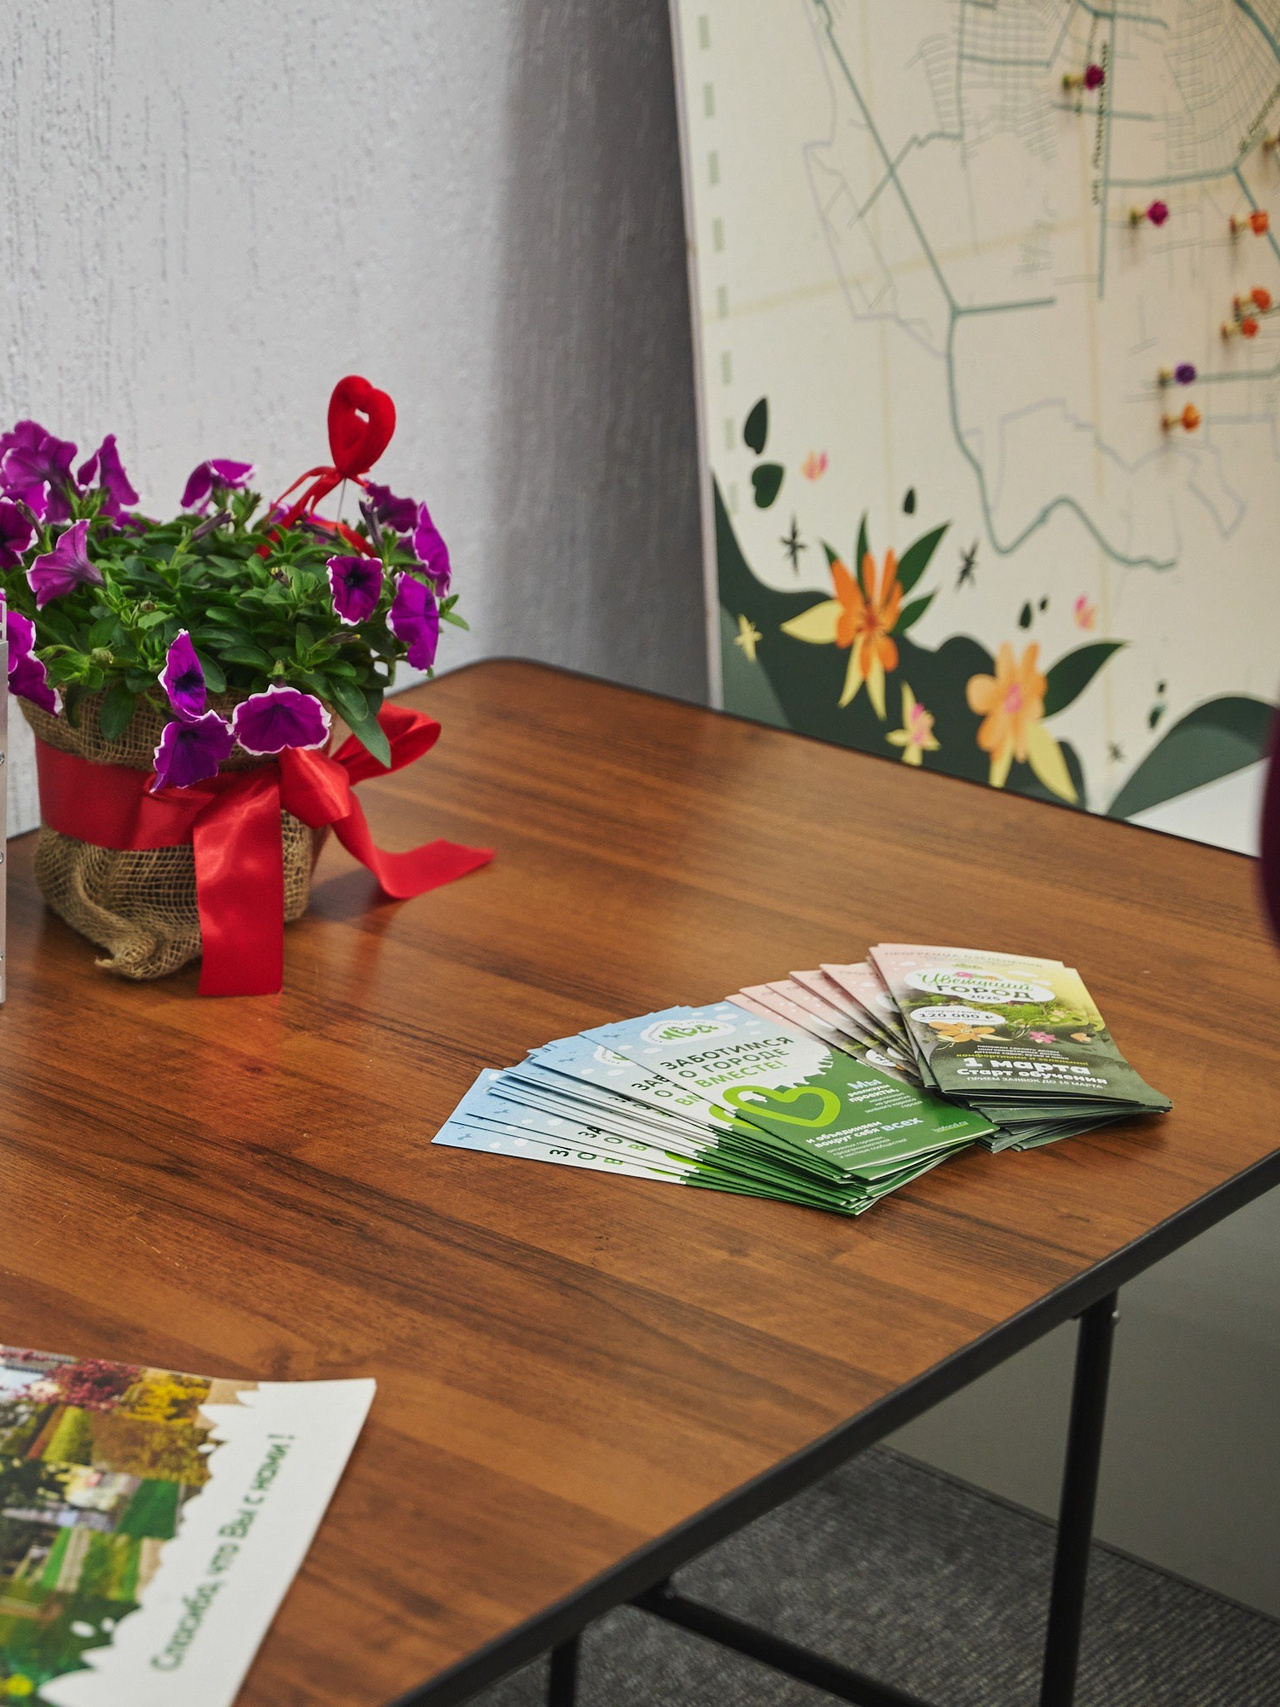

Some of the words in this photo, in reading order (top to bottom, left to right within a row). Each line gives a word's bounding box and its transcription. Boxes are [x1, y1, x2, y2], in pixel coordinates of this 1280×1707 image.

[920, 972, 1034, 992] Цветущий
[936, 985, 1034, 1000] ГОРОД
[660, 1036, 795, 1070] ЗАБОТИМСЯ
[678, 1070, 697, 1078] О
[701, 1048, 790, 1073] ГОРОДЕ
[694, 1060, 788, 1088] ВМЕСТЕ!
[963, 1057, 983, 1068] 1
[990, 1059, 1091, 1075] марта
[846, 1079, 883, 1090] Мы
[956, 1068, 1013, 1078] Старт
[1018, 1070, 1108, 1085] обучения
[1071, 1081, 1104, 1090] МАРТА
[848, 1089, 900, 1103] проекты,
[814, 1134, 852, 1149] вокруг
[854, 1127, 881, 1138] себя
[880, 1117, 924, 1132] всех
[815, 1120, 883, 1141] объединяем
[250, 1443, 291, 1492] нами
[243, 1494, 265, 1505] с
[218, 1509, 258, 1539] Вы
